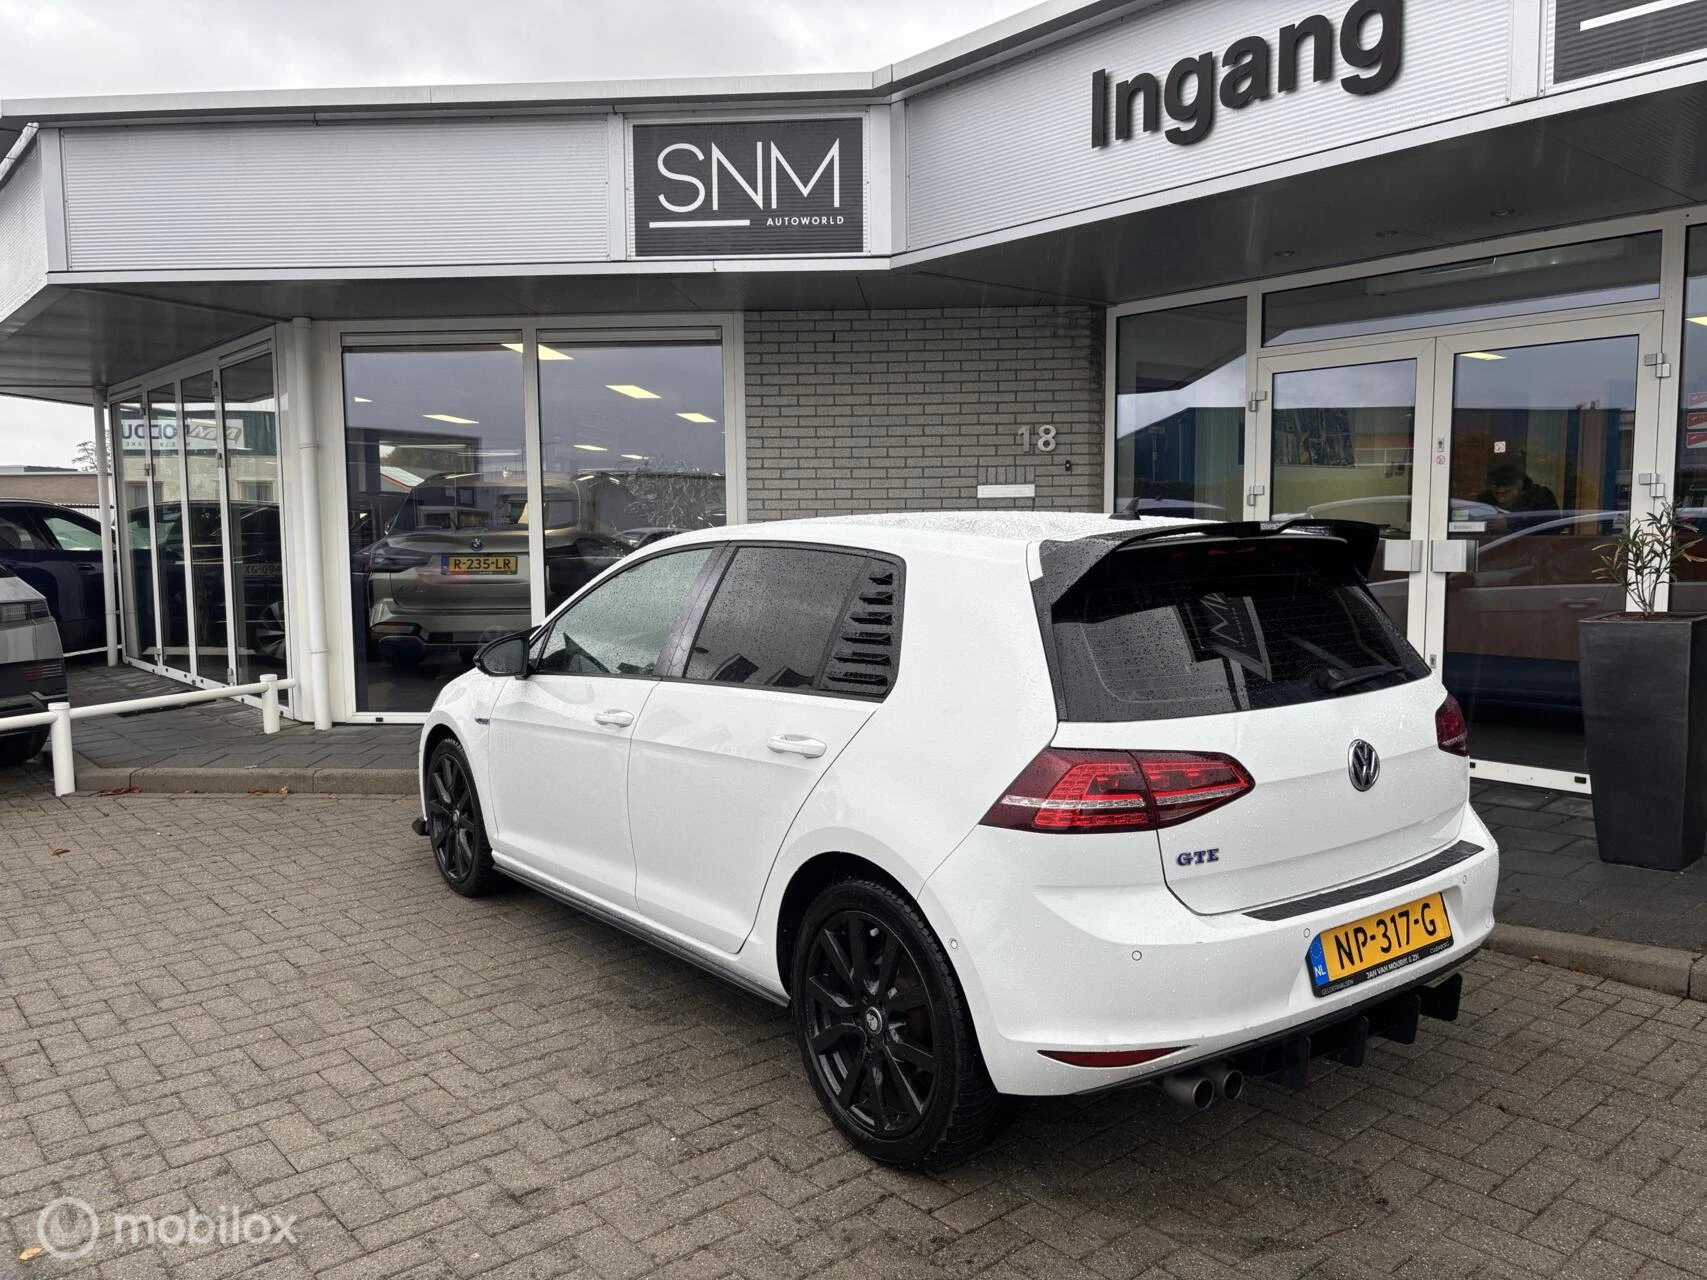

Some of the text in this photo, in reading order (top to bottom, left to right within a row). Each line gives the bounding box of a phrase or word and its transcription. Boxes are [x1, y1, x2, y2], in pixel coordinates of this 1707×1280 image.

[1092, 0, 1402, 148] Ingang
[657, 138, 840, 212] SNM
[766, 216, 844, 226] AUTOWORLD
[1017, 424, 1057, 453] 18
[453, 558, 511, 570] R-235-LR
[1176, 848, 1219, 866] GTE
[1334, 902, 1437, 970] NP-317-G
[1314, 964, 1326, 977] NL
[1366, 969, 1377, 979] JAN
[1377, 964, 1389, 974] VAN
